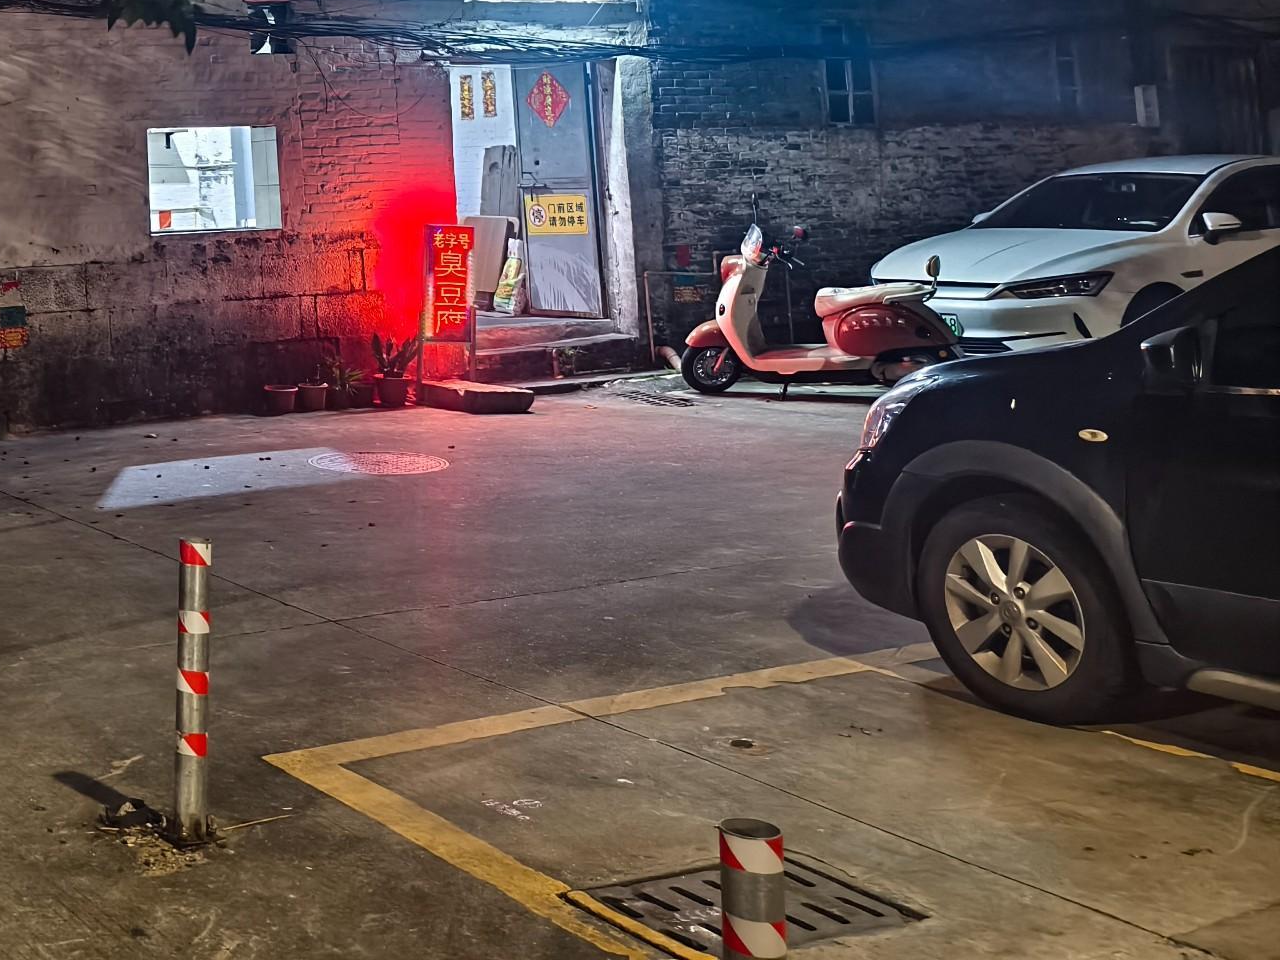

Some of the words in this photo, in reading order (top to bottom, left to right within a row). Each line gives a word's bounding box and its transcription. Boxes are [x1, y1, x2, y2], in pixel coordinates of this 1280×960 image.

[548, 202, 584, 213] 门前区域
[549, 215, 585, 227] 请勿停车
[433, 231, 470, 249] 老字号
